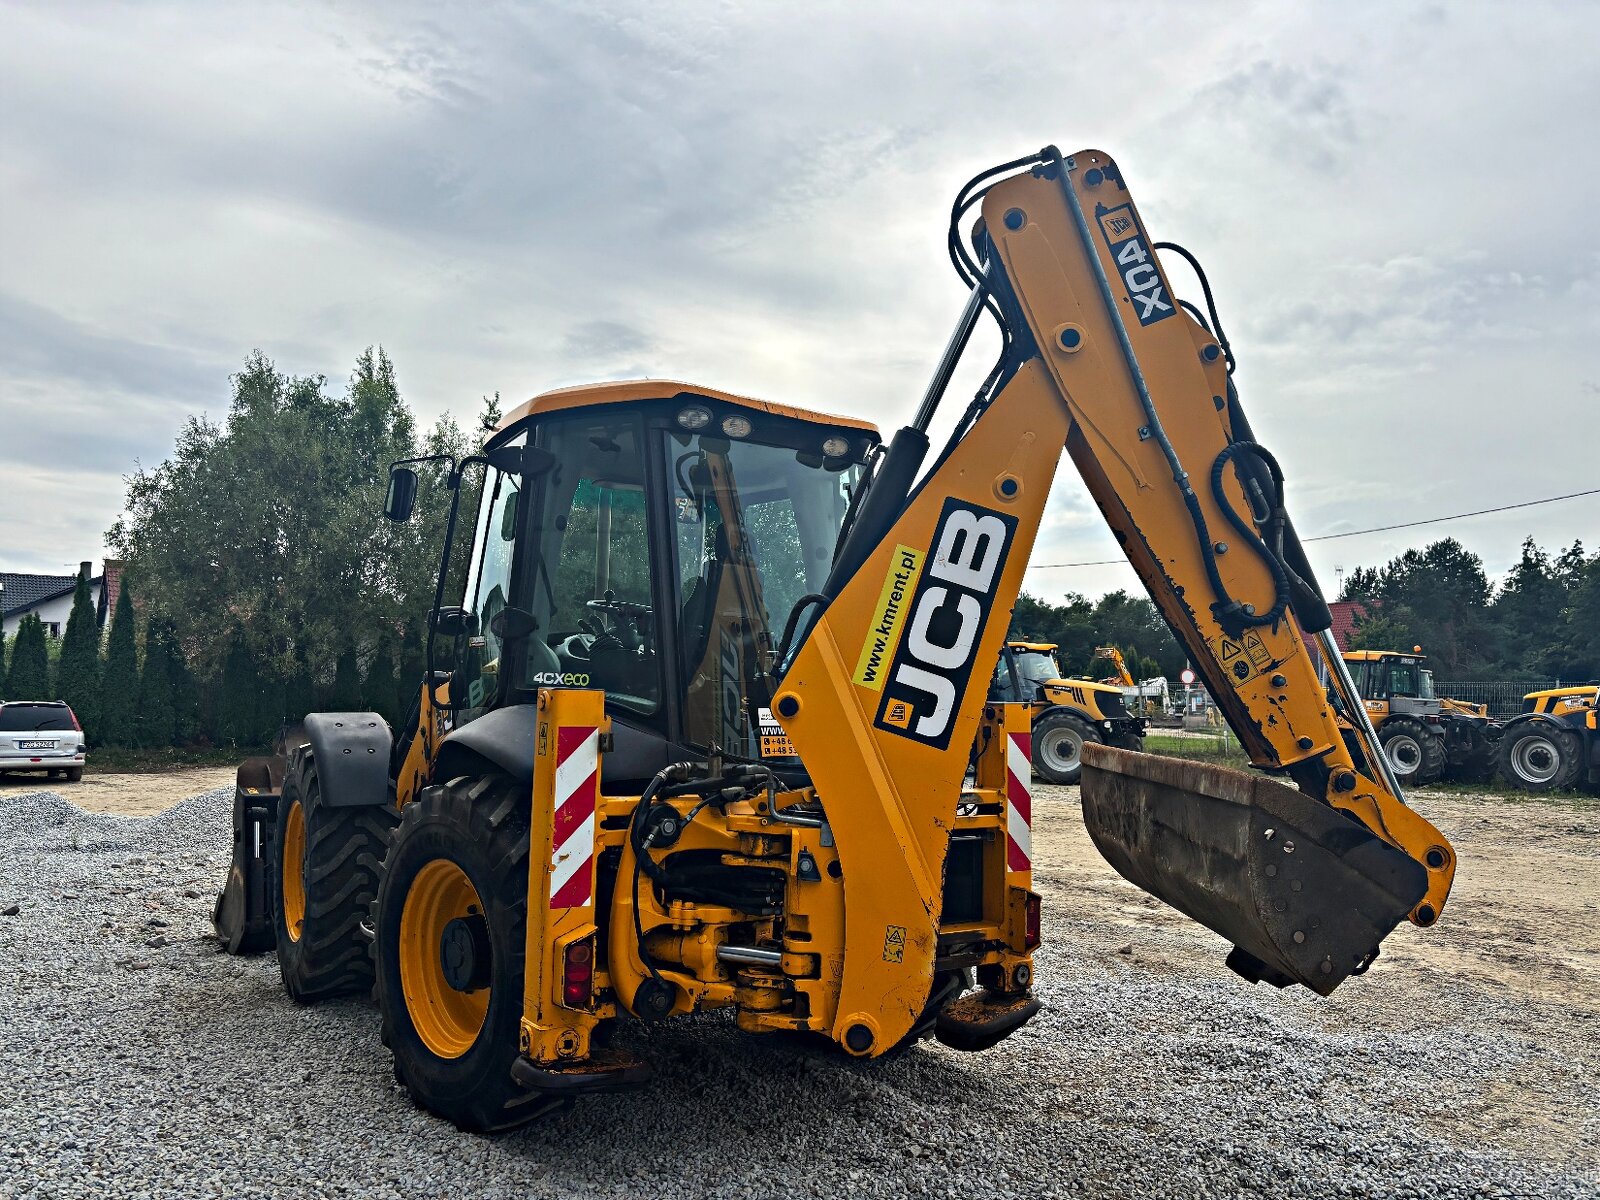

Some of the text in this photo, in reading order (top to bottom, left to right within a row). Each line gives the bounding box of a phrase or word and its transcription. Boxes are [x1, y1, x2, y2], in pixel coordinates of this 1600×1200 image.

[1108, 217, 1132, 235] JCB
[1117, 239, 1173, 320] 4CX
[863, 550, 916, 683] www.kmrent.pl
[896, 509, 1007, 738] JCB
